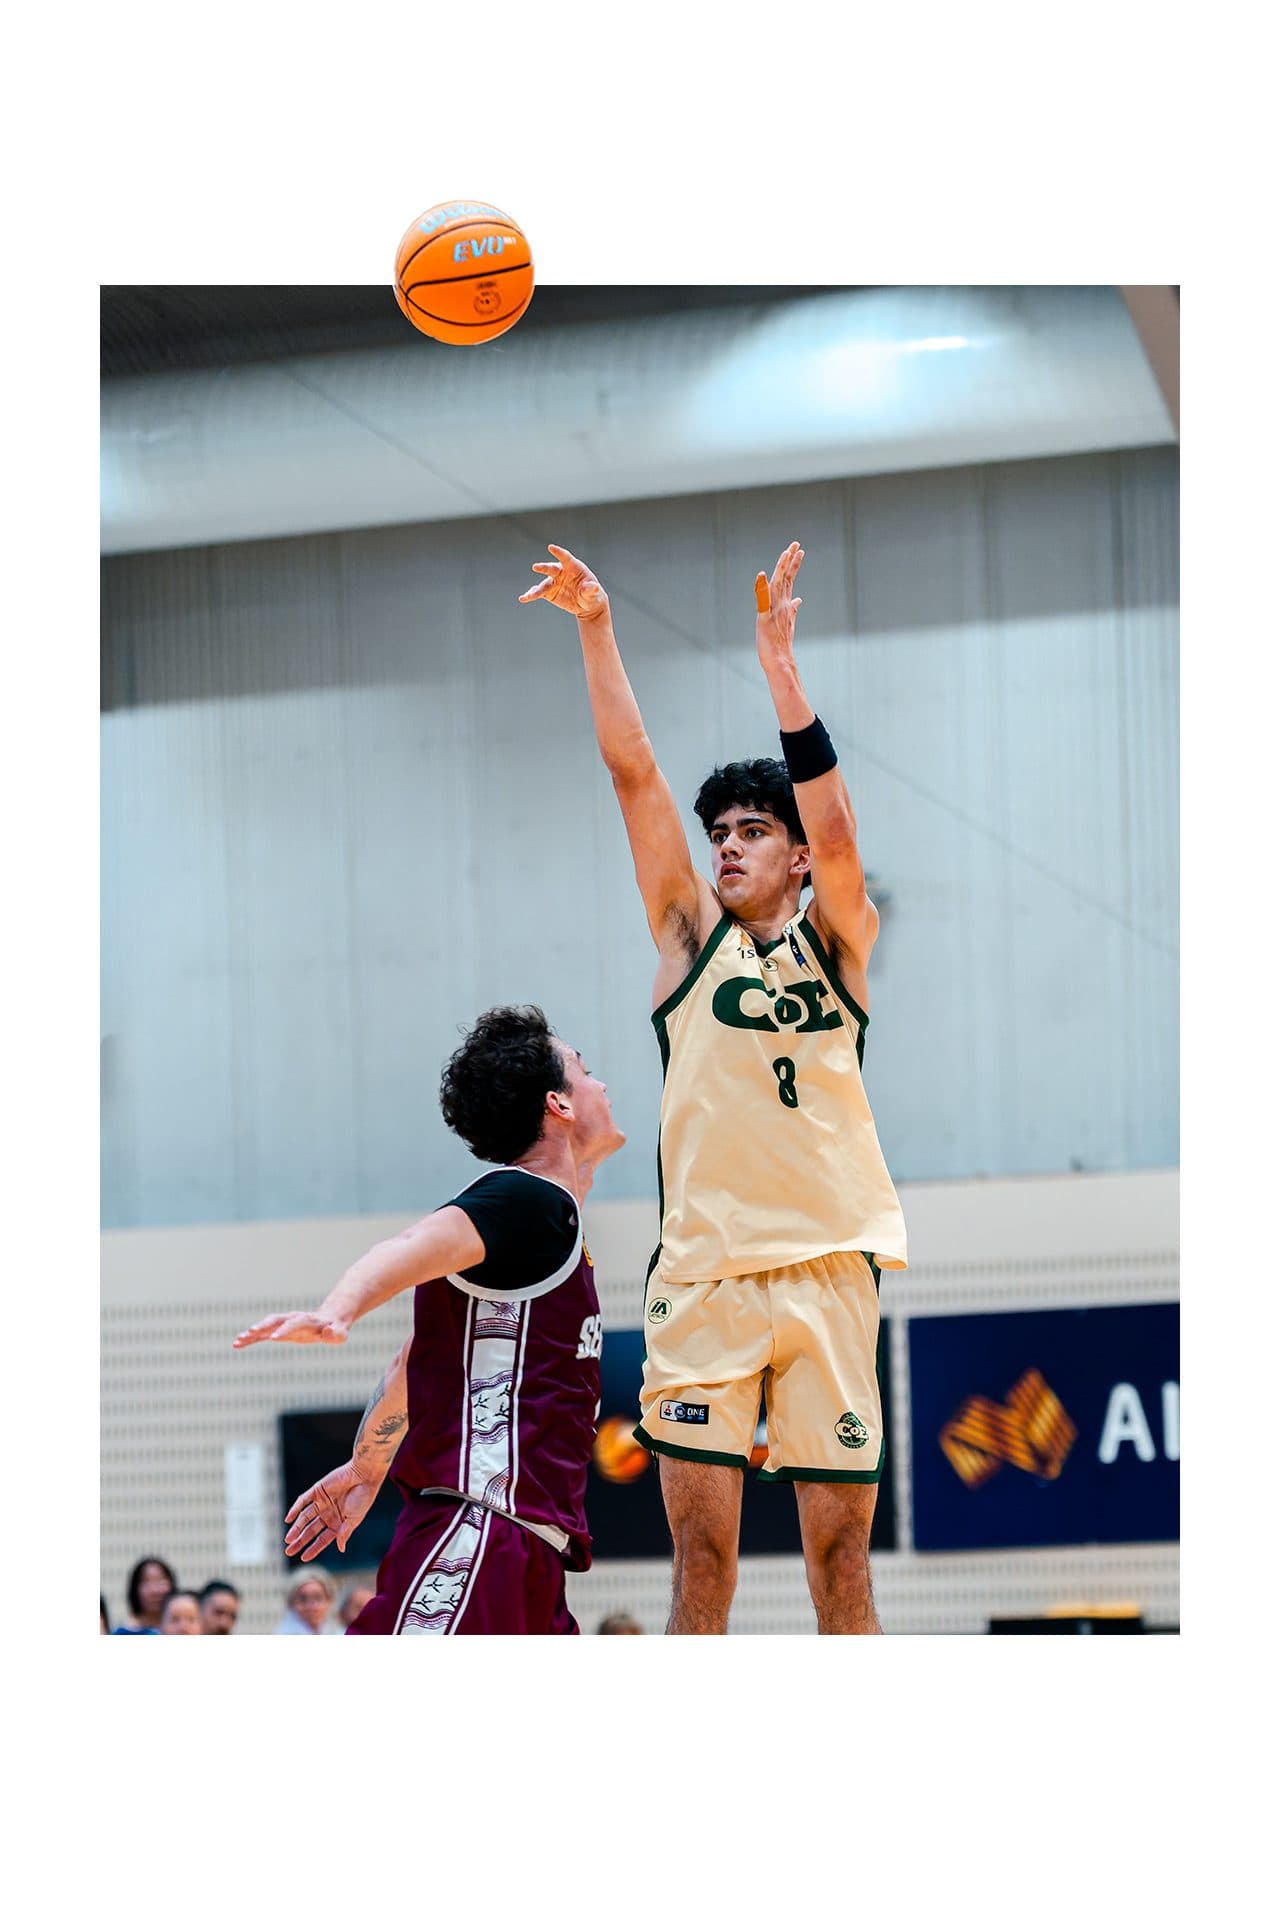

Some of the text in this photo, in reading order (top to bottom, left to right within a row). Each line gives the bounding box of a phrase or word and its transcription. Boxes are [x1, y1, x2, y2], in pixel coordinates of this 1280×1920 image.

[453, 236, 504, 263] EVO
[772, 1056, 799, 1108] 8
[687, 1407, 705, 1417] ONE
